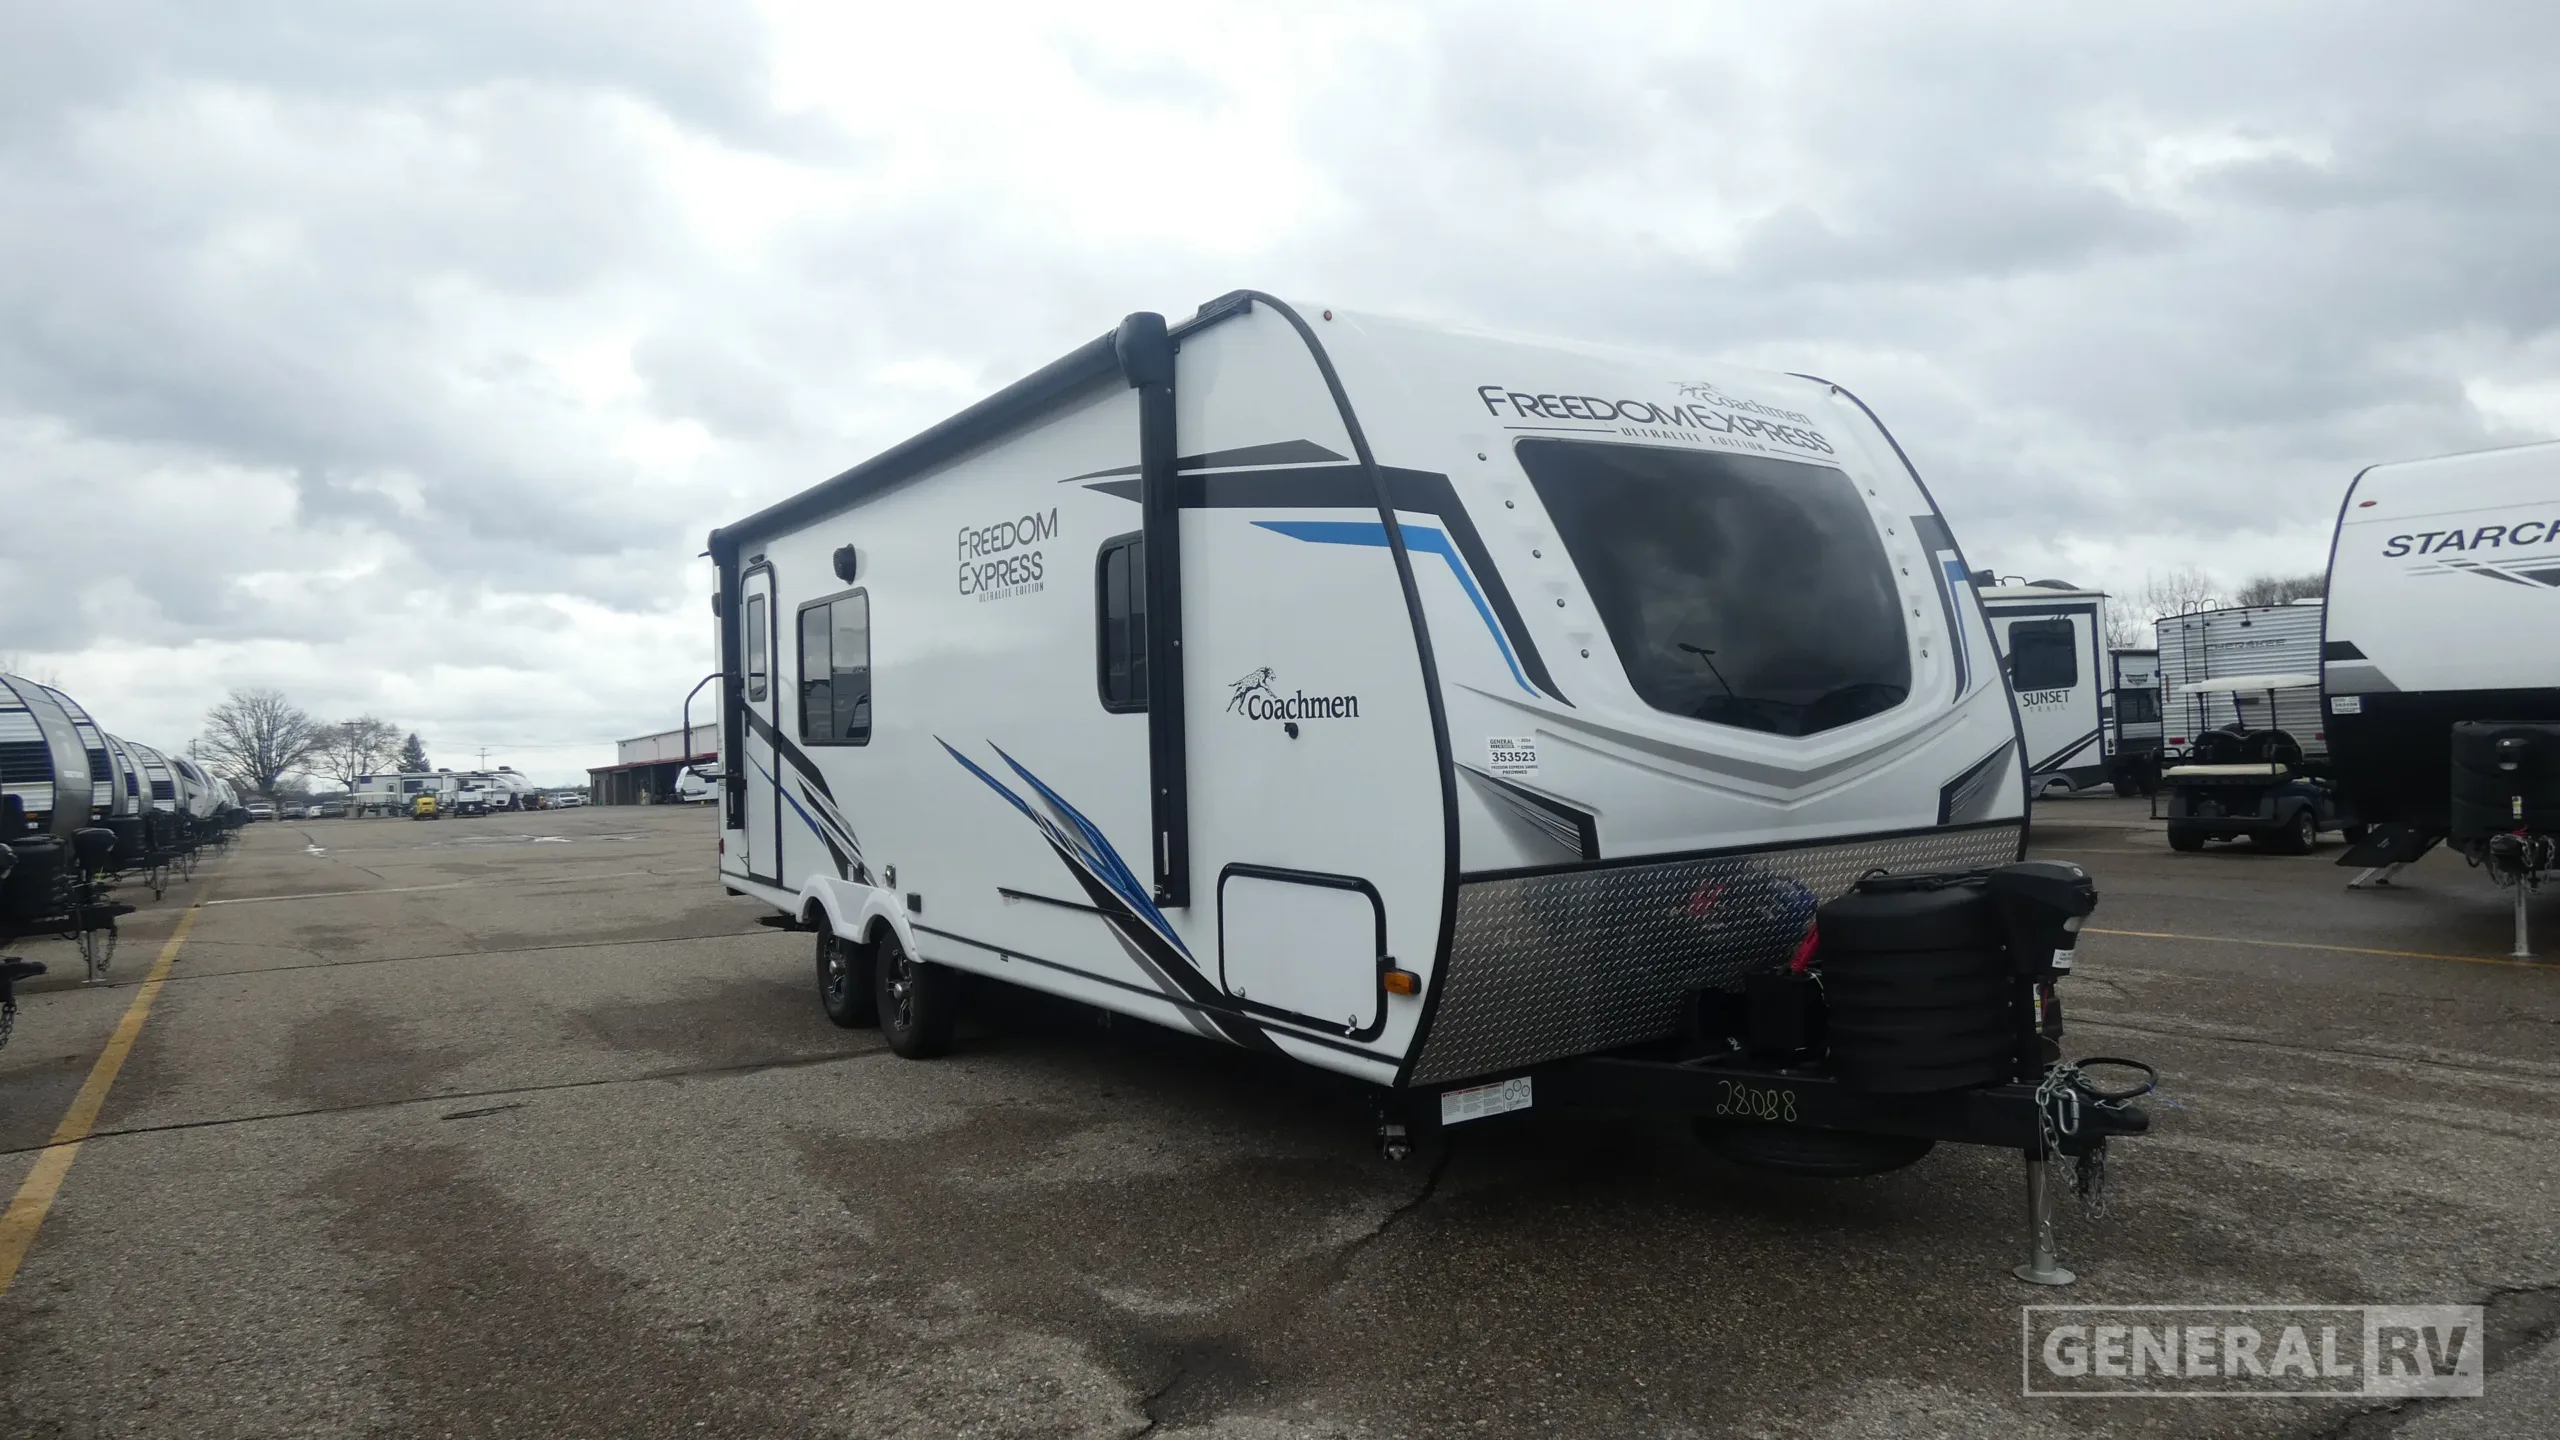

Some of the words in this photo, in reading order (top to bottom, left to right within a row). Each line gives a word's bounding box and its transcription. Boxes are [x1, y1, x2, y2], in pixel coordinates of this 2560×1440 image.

[1701, 391, 1814, 427] Coachmen
[1620, 427, 1702, 443] ULTRALITE
[1710, 435, 1767, 452] EDITION
[958, 507, 1058, 562] FREEDOM
[959, 550, 1044, 596] EXPRESS
[979, 587, 1012, 603] ULTRALITE
[1015, 581, 1044, 597] EDITION
[1248, 689, 1360, 721] Coachmen
[2022, 689, 2070, 708] SUNSET
[2029, 703, 2067, 713] TRAIL
[1491, 751, 1537, 763] 353523
[1716, 1080, 1797, 1122] 28088
